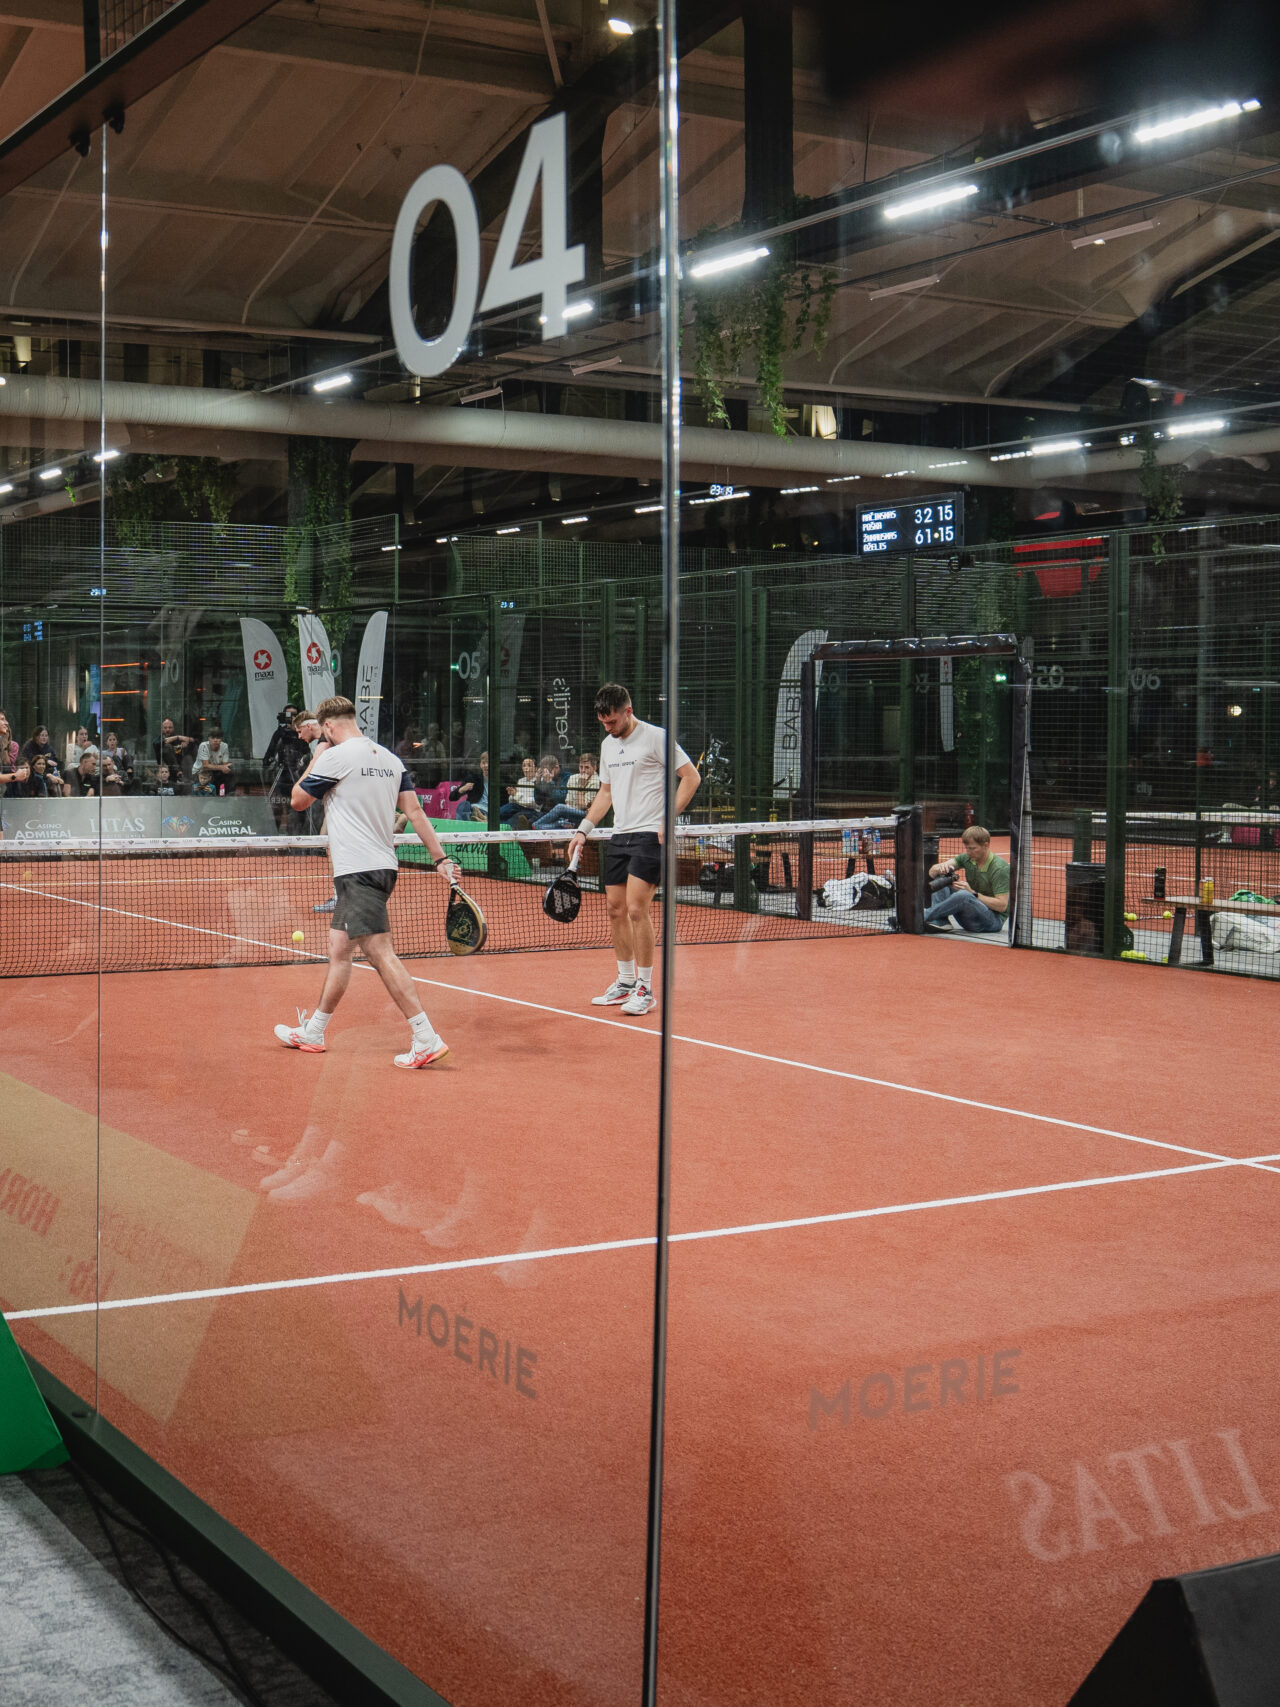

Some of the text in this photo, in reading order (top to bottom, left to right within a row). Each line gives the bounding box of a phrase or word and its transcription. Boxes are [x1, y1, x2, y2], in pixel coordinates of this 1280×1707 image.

[389, 111, 586, 378] 04
[937, 505, 953, 521] 15
[938, 526, 954, 542] 15
[458, 651, 481, 680] 05
[361, 767, 395, 778] LIETUVA
[25, 820, 62, 830] CASINO
[89, 817, 146, 833] LITAS
[208, 816, 242, 826] CASINO
[15, 829, 79, 840] ADMIRAL
[198, 825, 257, 837] ADMIRAL
